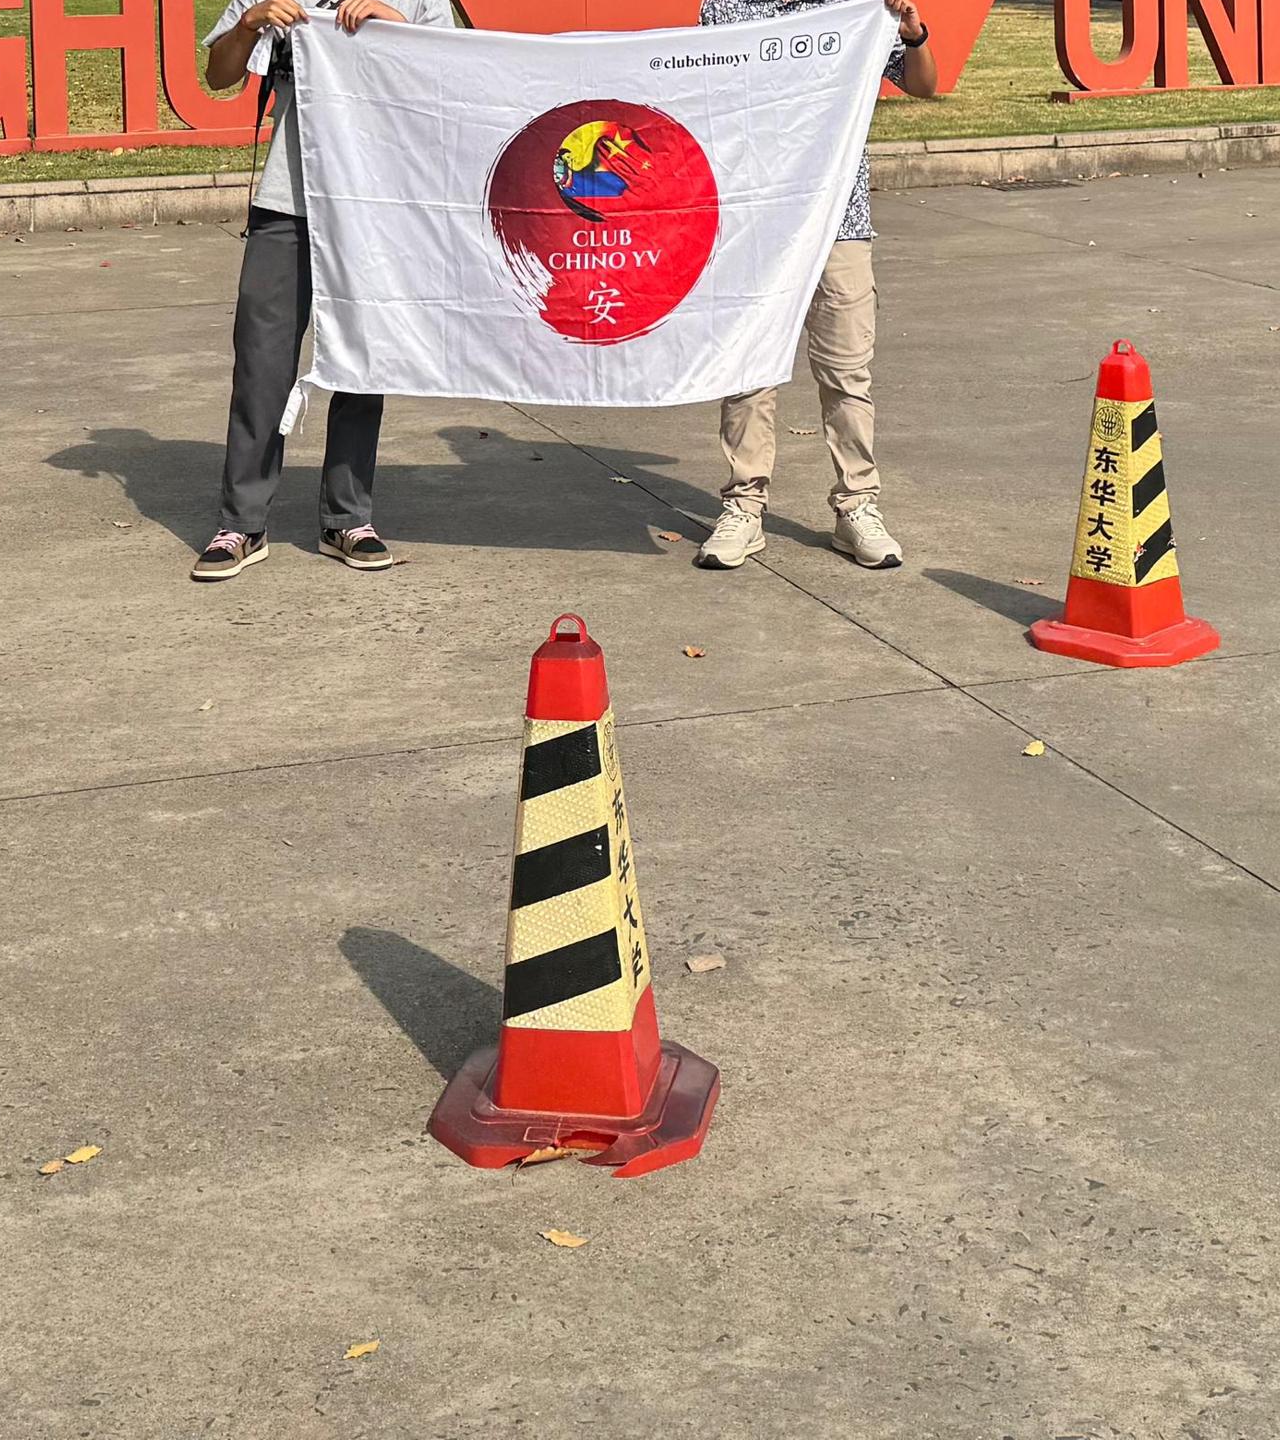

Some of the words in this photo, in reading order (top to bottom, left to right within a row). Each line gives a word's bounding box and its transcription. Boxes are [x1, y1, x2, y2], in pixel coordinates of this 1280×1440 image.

[649, 52, 751, 71] @clubchinoyv
[572, 229, 632, 247] CLUB
[548, 251, 626, 270] CHINO
[631, 249, 662, 267] YV
[582, 280, 625, 325] 安
[1086, 446, 1119, 572] 东华大学
